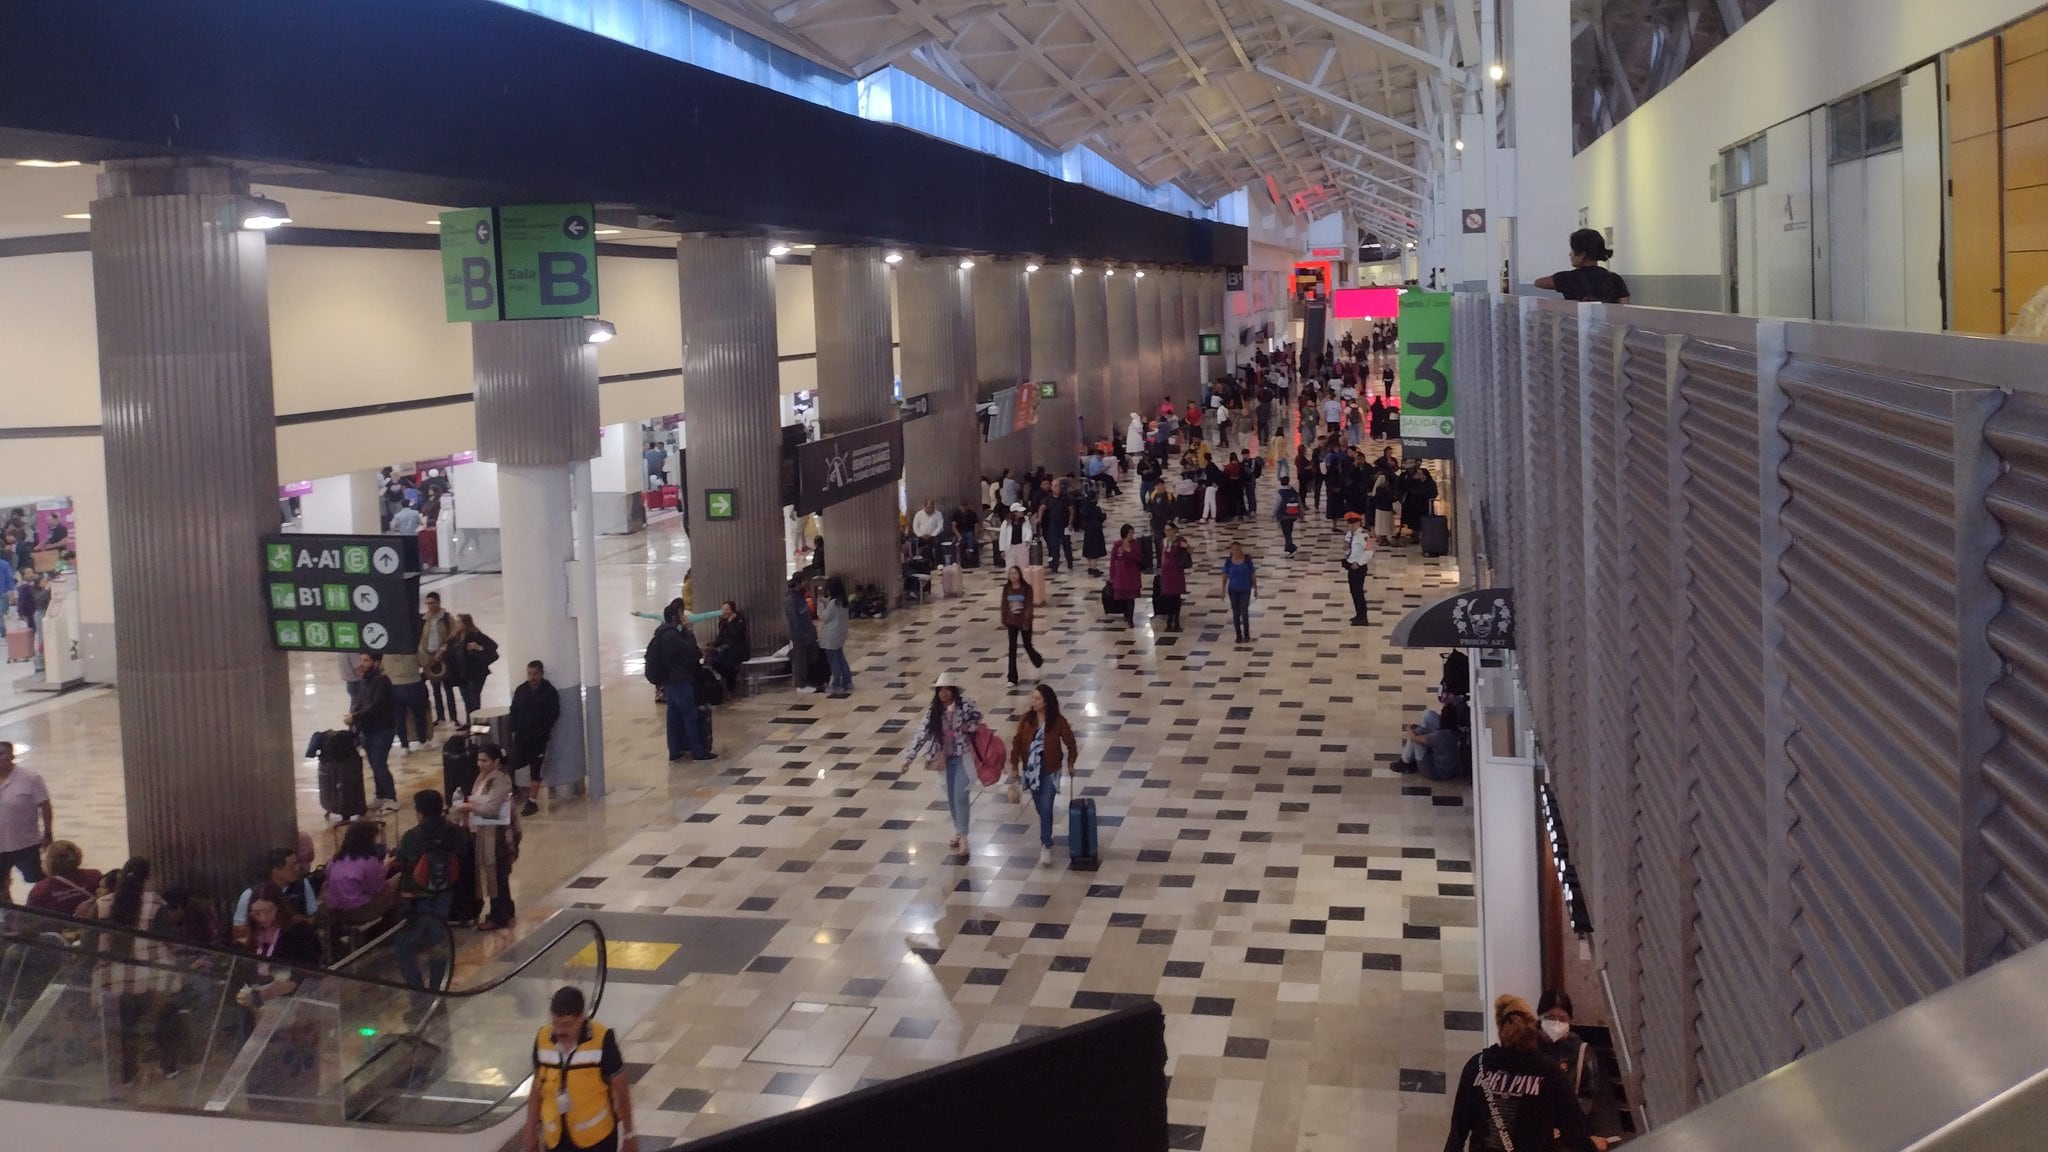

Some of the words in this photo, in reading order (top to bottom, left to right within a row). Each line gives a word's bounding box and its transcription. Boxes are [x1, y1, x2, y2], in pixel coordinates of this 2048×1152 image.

[462, 256, 495, 310] B
[507, 268, 536, 280] Sala
[538, 251, 592, 306] B
[1405, 342, 1449, 410] 3
[1401, 417, 1438, 427] SALIDA
[298, 587, 322, 606] B1
[1508, 1074, 1543, 1096] PINK
